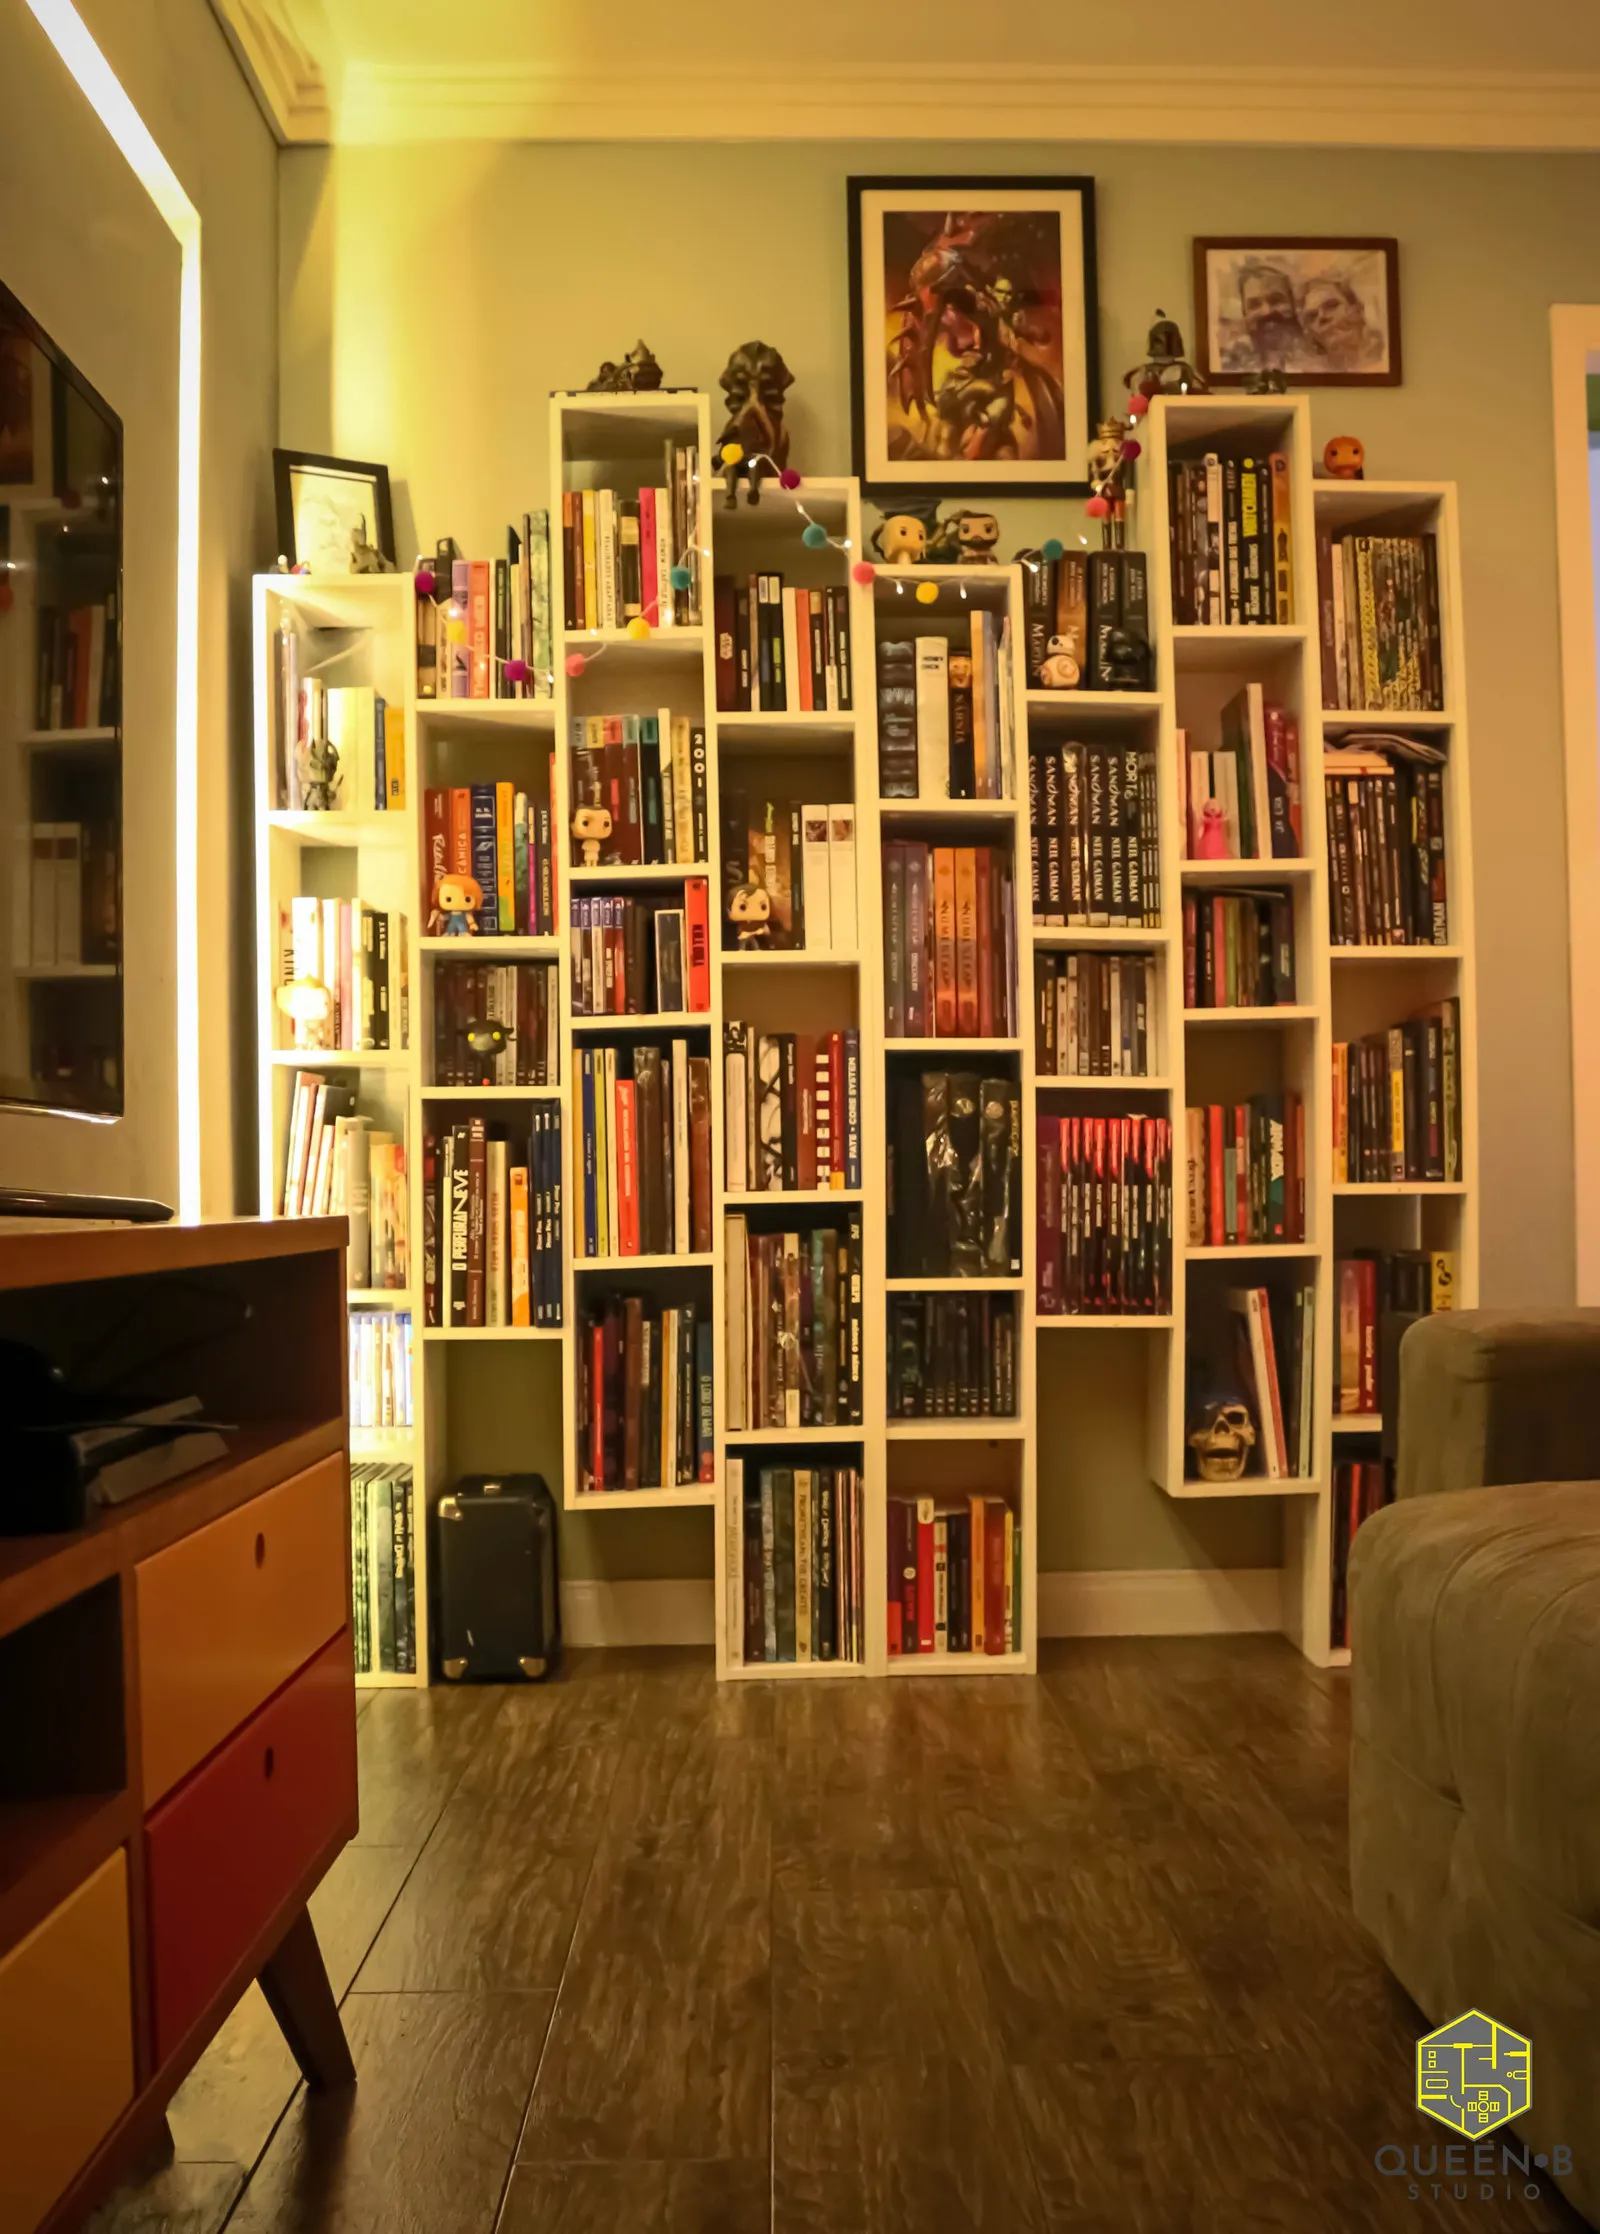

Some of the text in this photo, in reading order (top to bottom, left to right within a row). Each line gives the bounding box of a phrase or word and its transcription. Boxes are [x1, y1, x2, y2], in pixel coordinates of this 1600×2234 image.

[1045, 755, 1059, 826] SANDMAN
[1090, 754, 1104, 825] SANDMAN
[1107, 755, 1121, 827] SANDMAN
[1048, 861, 1060, 902] GAIMAN
[1093, 860, 1104, 901] GAIMAN
[1112, 862, 1122, 903] GAIMAN
[1128, 861, 1140, 902] GAIMAN
[1269, 1118, 1284, 1183] ARMADA
